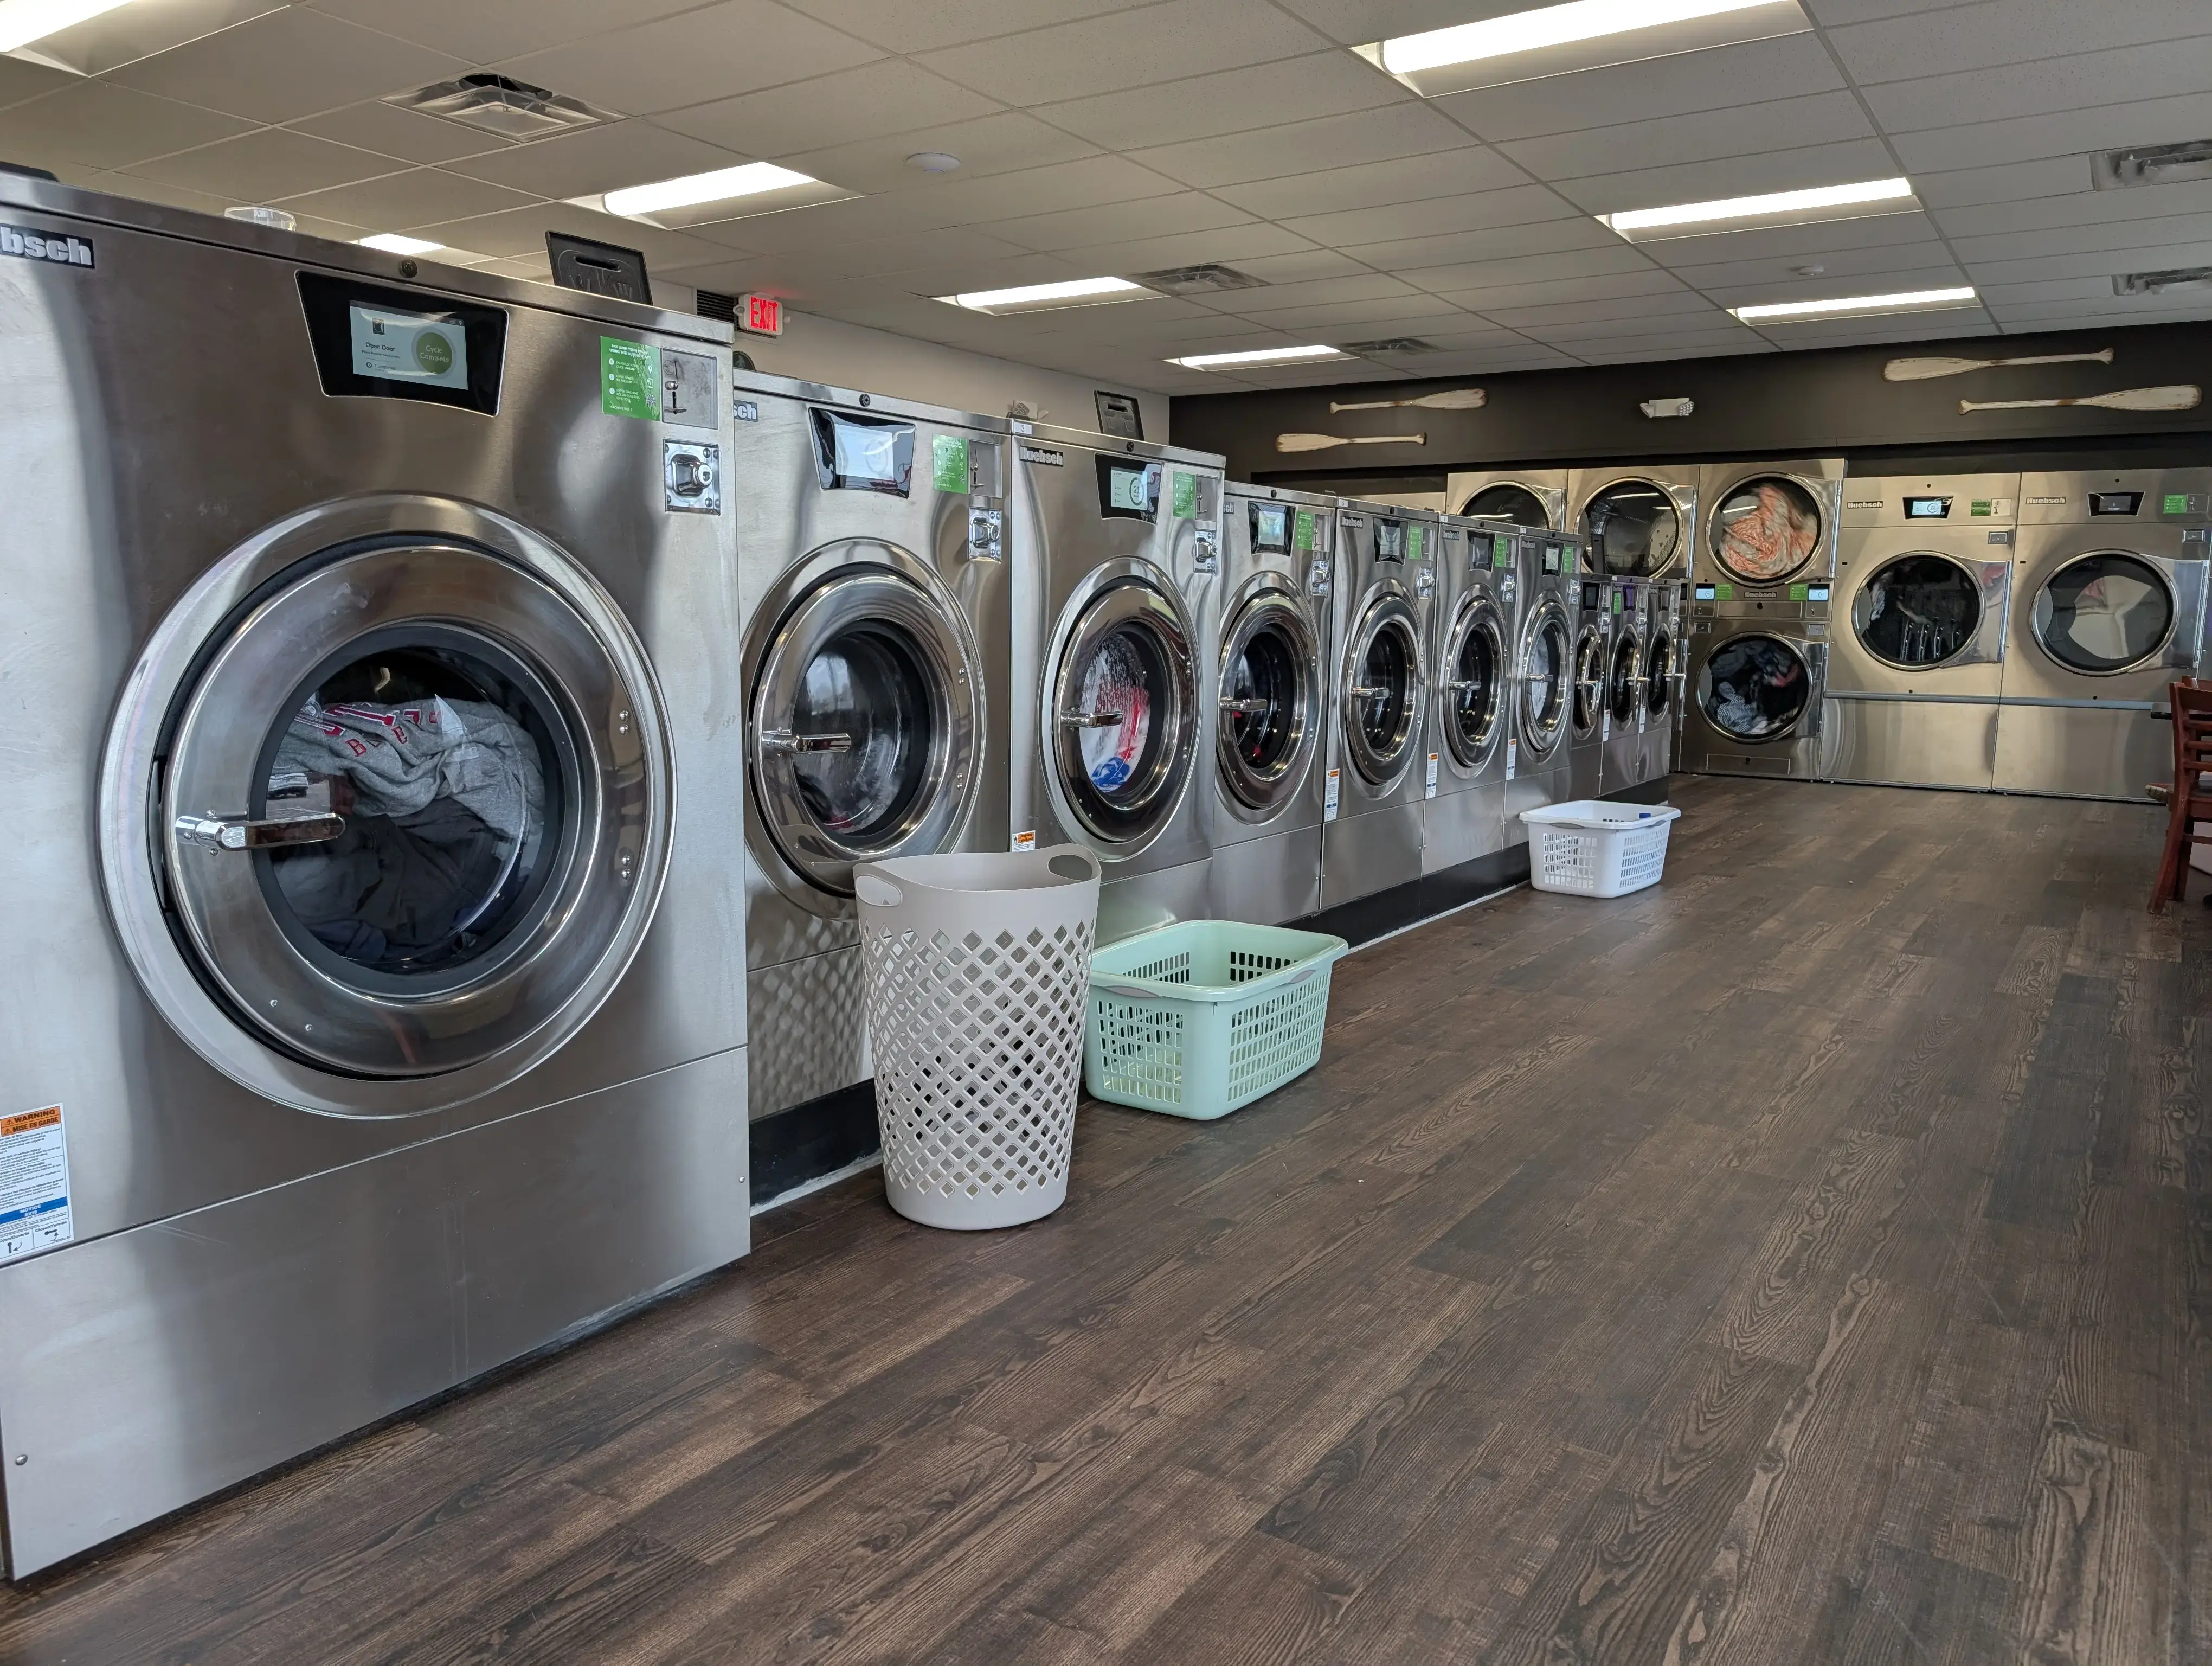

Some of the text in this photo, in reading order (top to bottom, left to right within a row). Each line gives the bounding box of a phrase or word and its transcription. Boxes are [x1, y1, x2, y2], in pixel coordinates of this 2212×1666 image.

[750, 297, 778, 332] EXIT
[365, 342, 381, 350] Open
[426, 345, 442, 354] Cycle
[420, 353, 450, 363] Complete
[1021, 424, 1025, 433] 3
[1019, 446, 1063, 465] Huebsch
[14, 1109, 55, 1123] WARNING
[12, 1124, 28, 1132] MISE
[38, 1117, 59, 1126] GARDE
[20, 1204, 41, 1213] NOTICE
